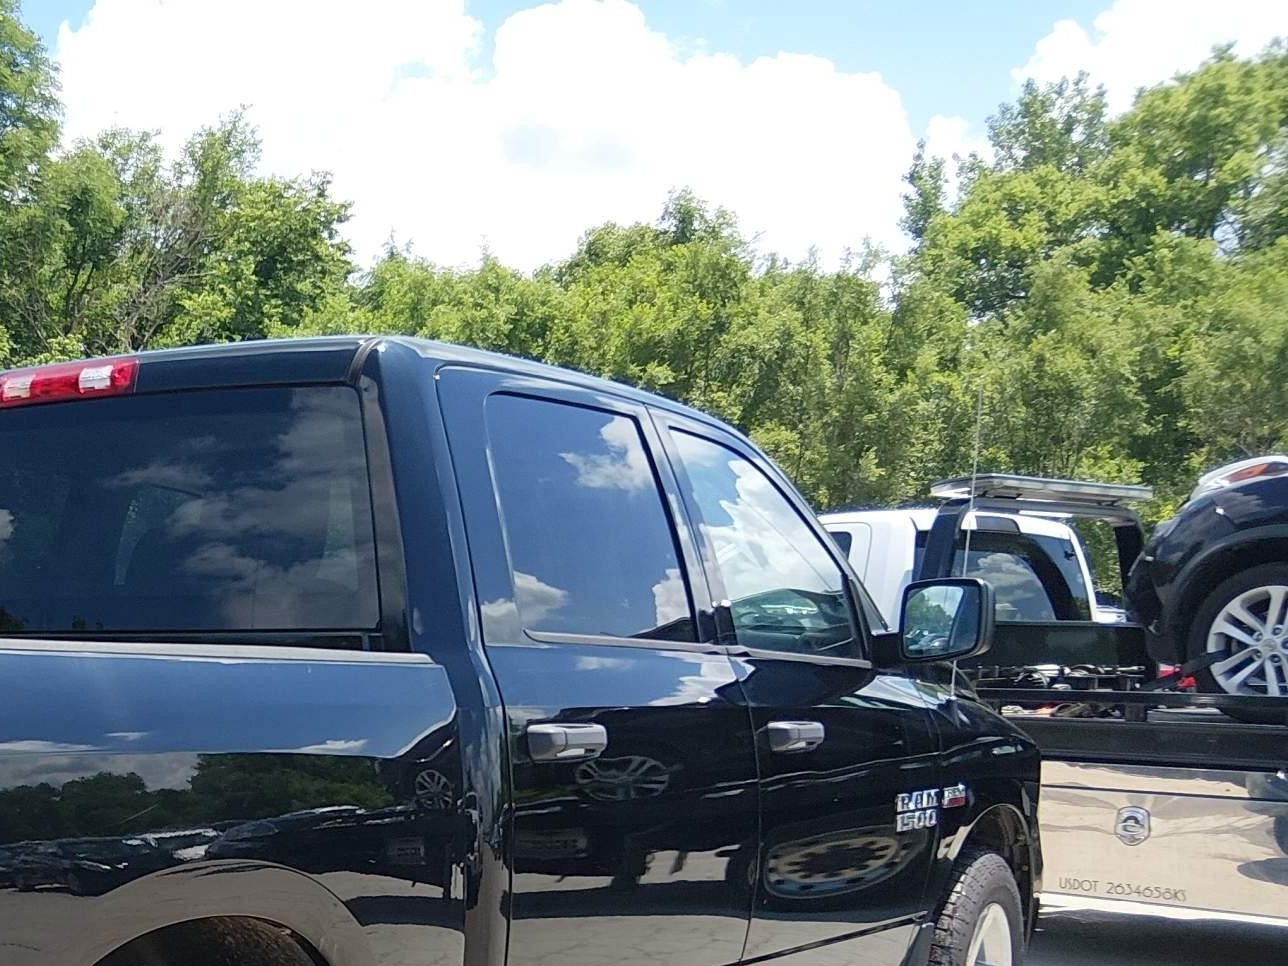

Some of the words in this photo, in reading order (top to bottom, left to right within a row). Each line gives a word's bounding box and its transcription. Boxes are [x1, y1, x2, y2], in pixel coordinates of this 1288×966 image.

[896, 788, 940, 812] RAM
[896, 809, 938, 832] 1500
[1058, 876, 1099, 893] USDOT
